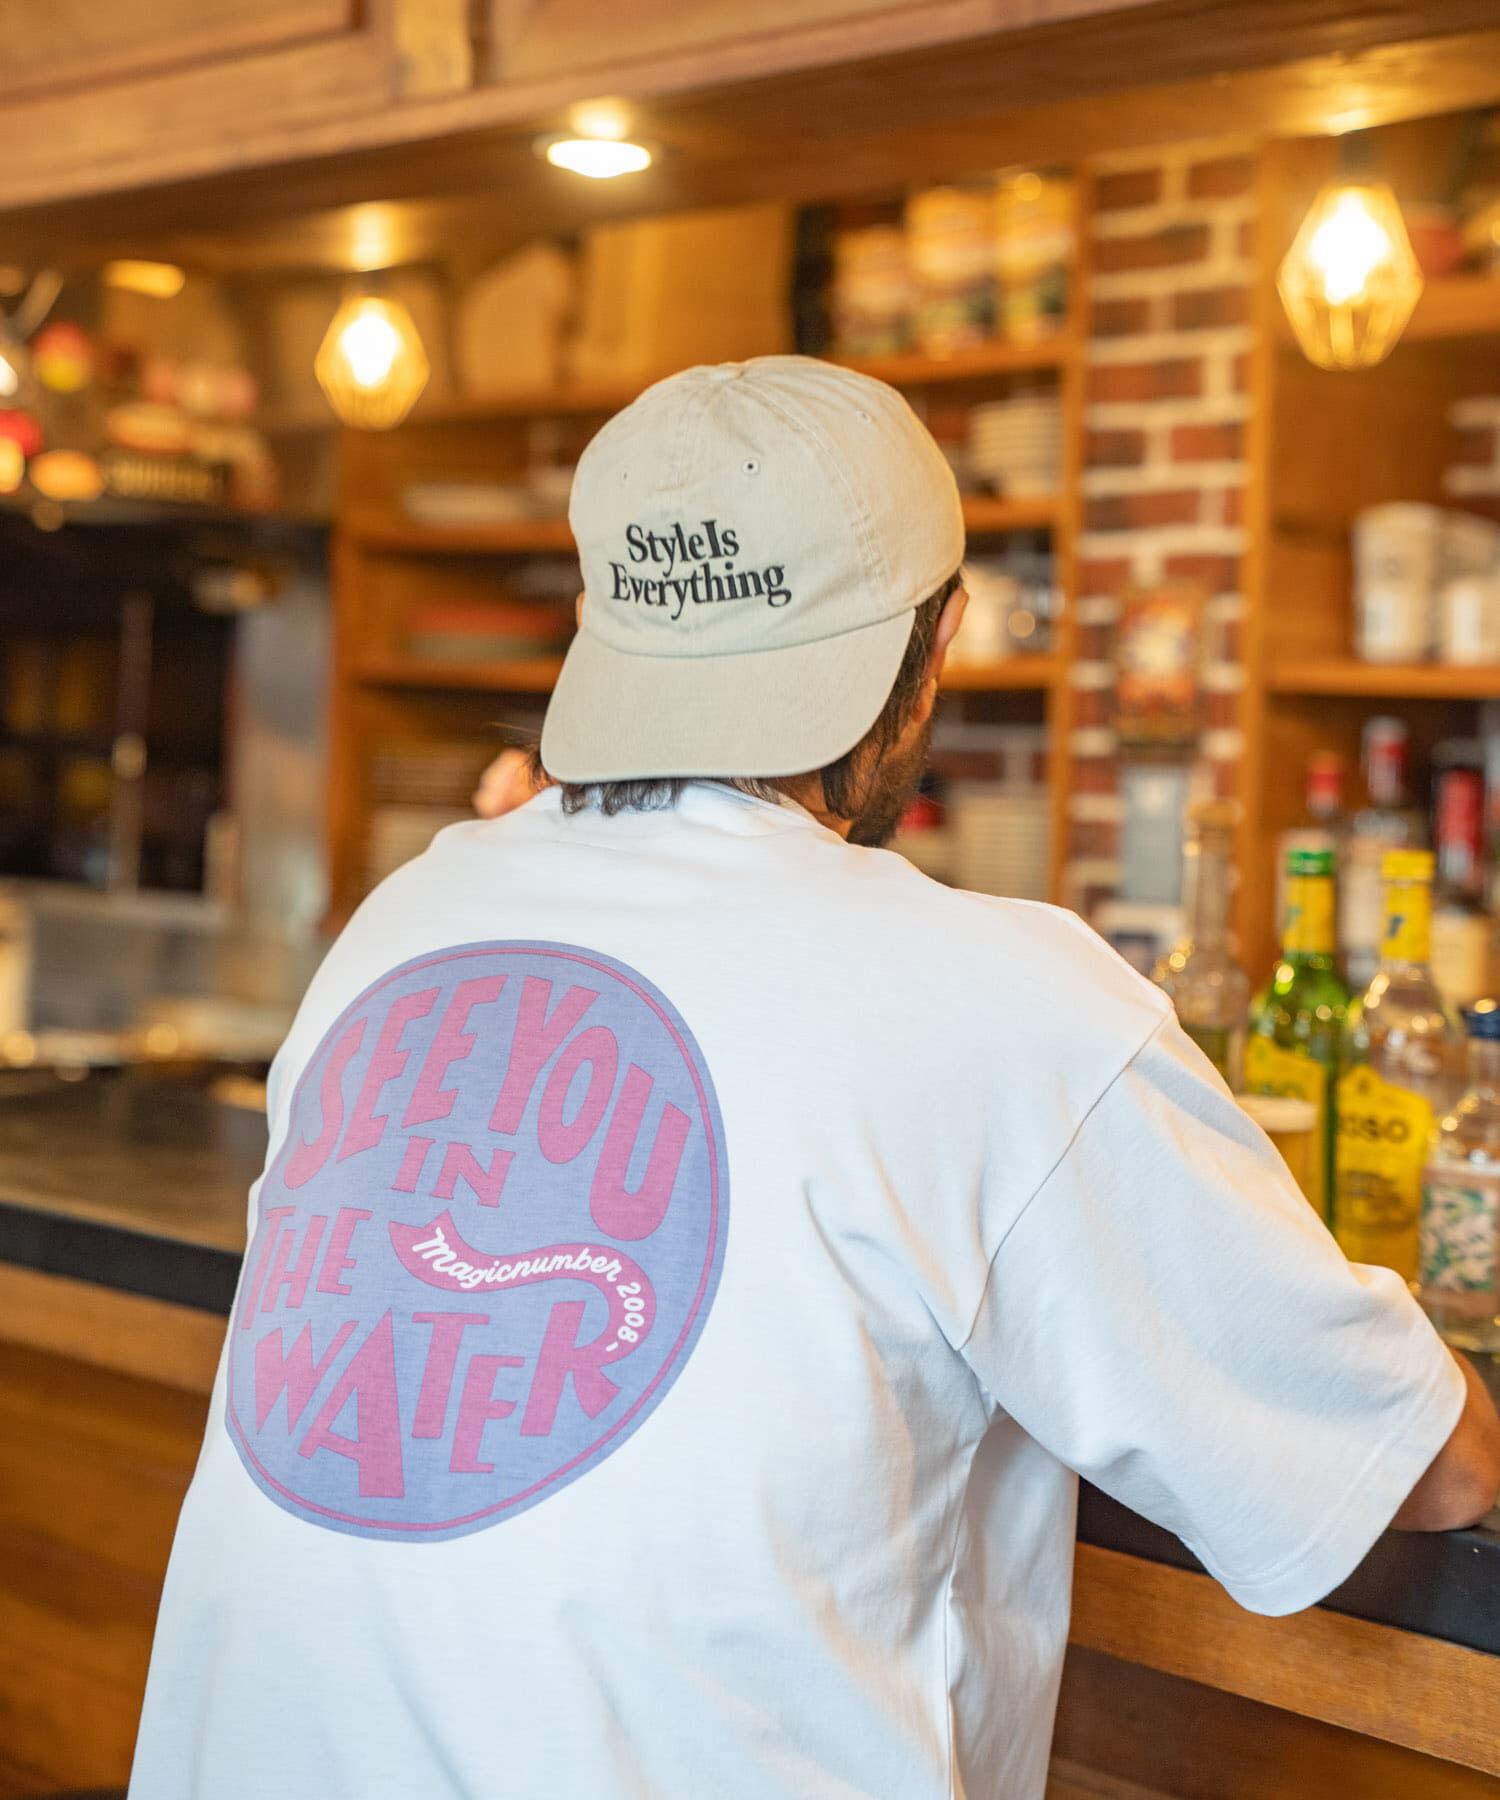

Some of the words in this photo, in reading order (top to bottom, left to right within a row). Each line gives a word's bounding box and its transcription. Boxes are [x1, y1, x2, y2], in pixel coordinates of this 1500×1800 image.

[608, 560, 792, 621] Everything
[282, 975, 508, 1190] SEE
[488, 974, 691, 1242] YOU
[391, 1136, 516, 1208] IN
[241, 1205, 373, 1330] THE
[411, 1226, 623, 1289] Magicnumber
[254, 1301, 657, 1498] WATER
